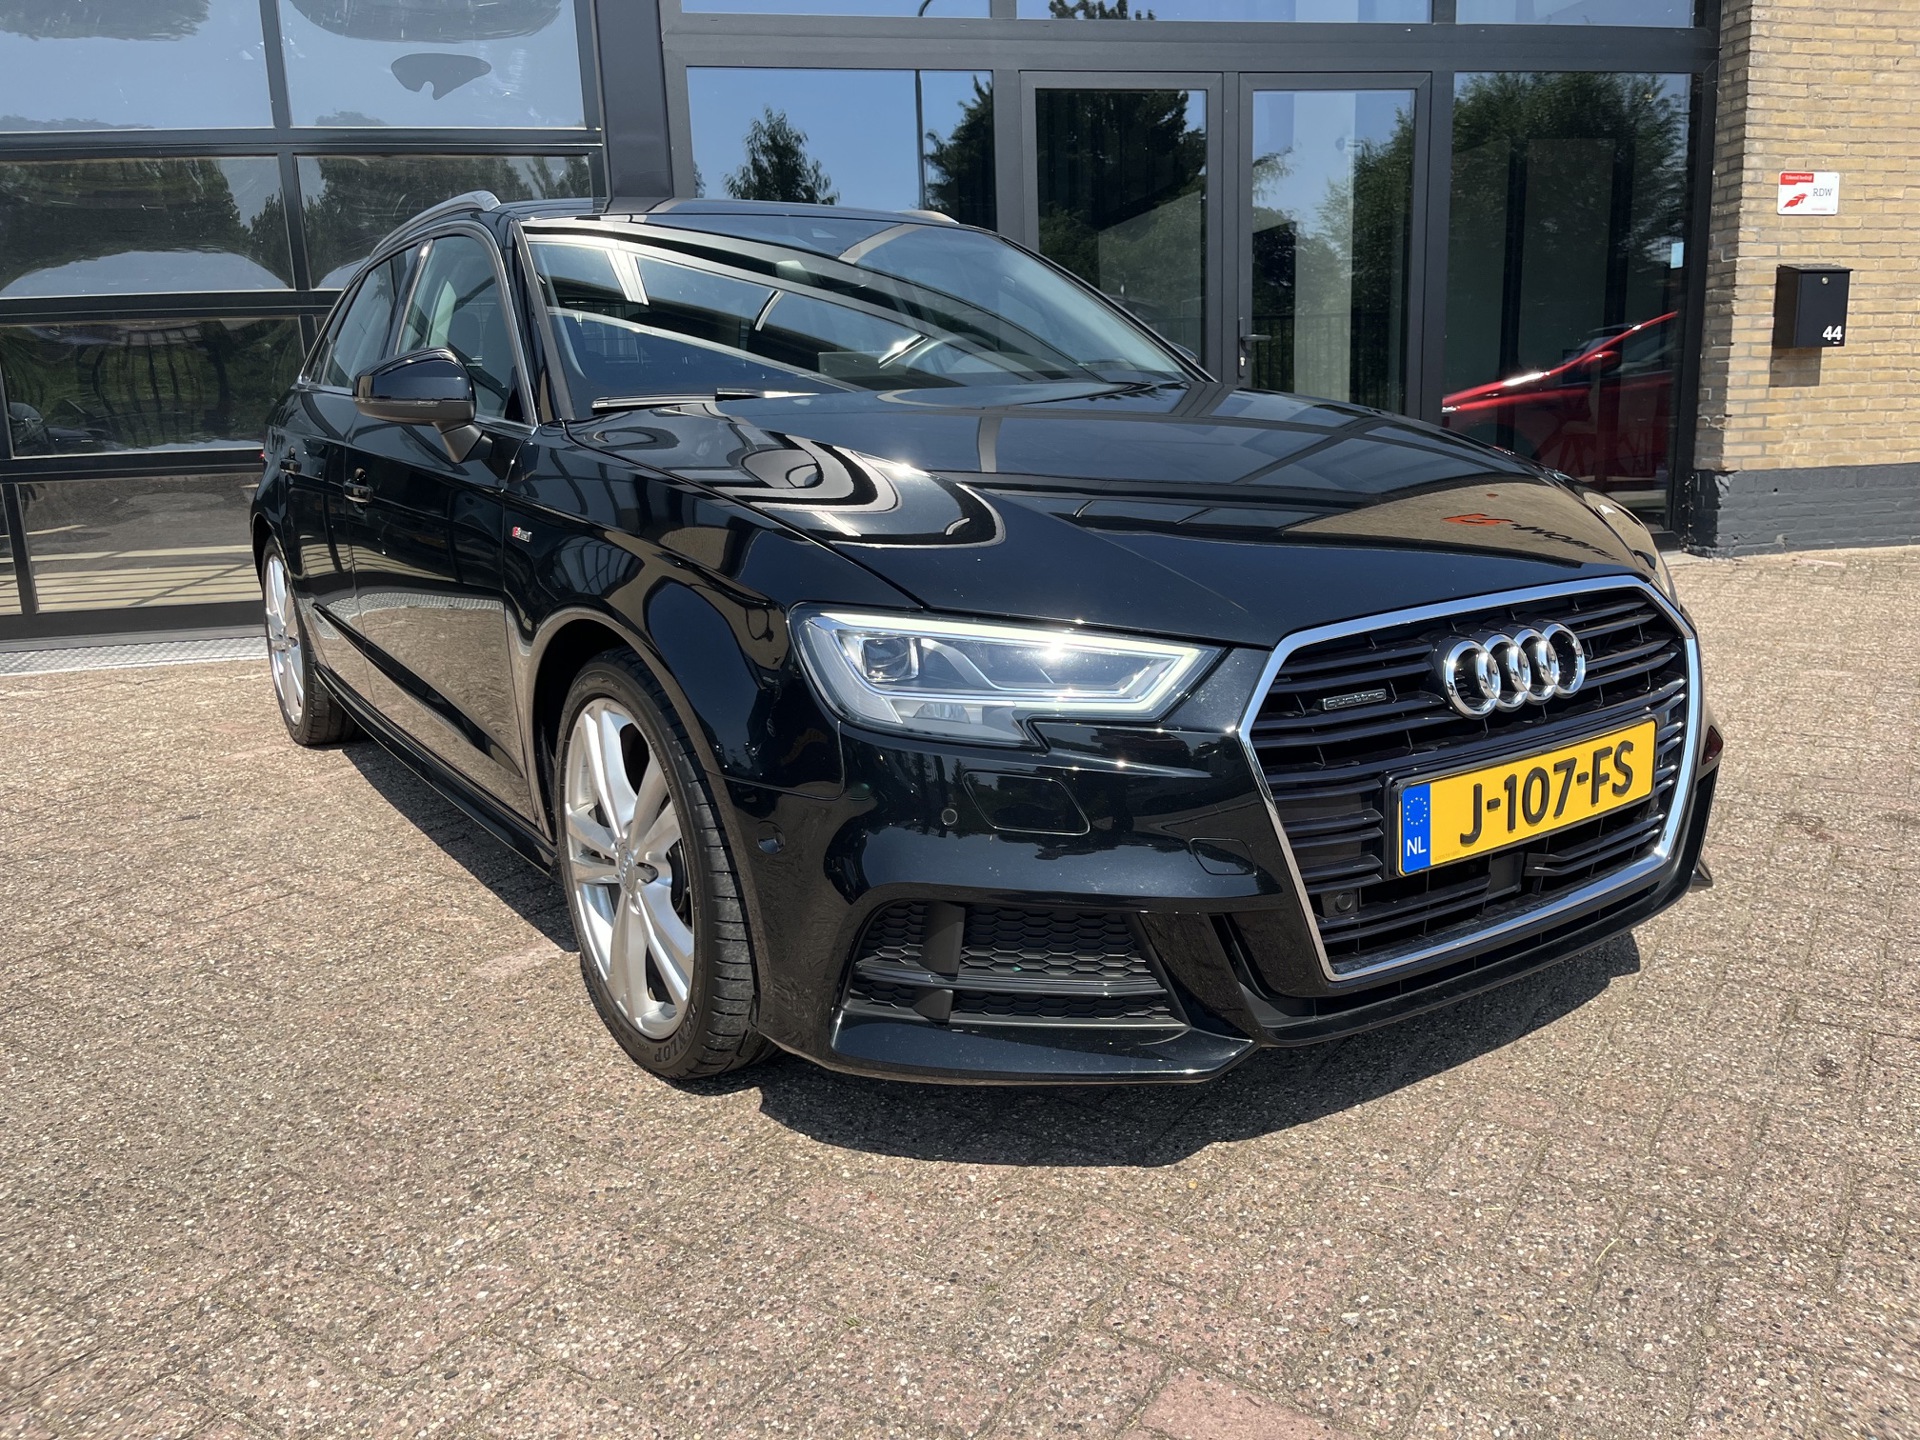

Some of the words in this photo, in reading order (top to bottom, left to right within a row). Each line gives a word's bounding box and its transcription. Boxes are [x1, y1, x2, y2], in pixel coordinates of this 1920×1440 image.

[1812, 188, 1833, 197] RDW
[1822, 325, 1843, 341] 44
[1327, 692, 1385, 708] quattro
[1460, 740, 1634, 848] J-107-FS
[1406, 836, 1427, 857] NL
